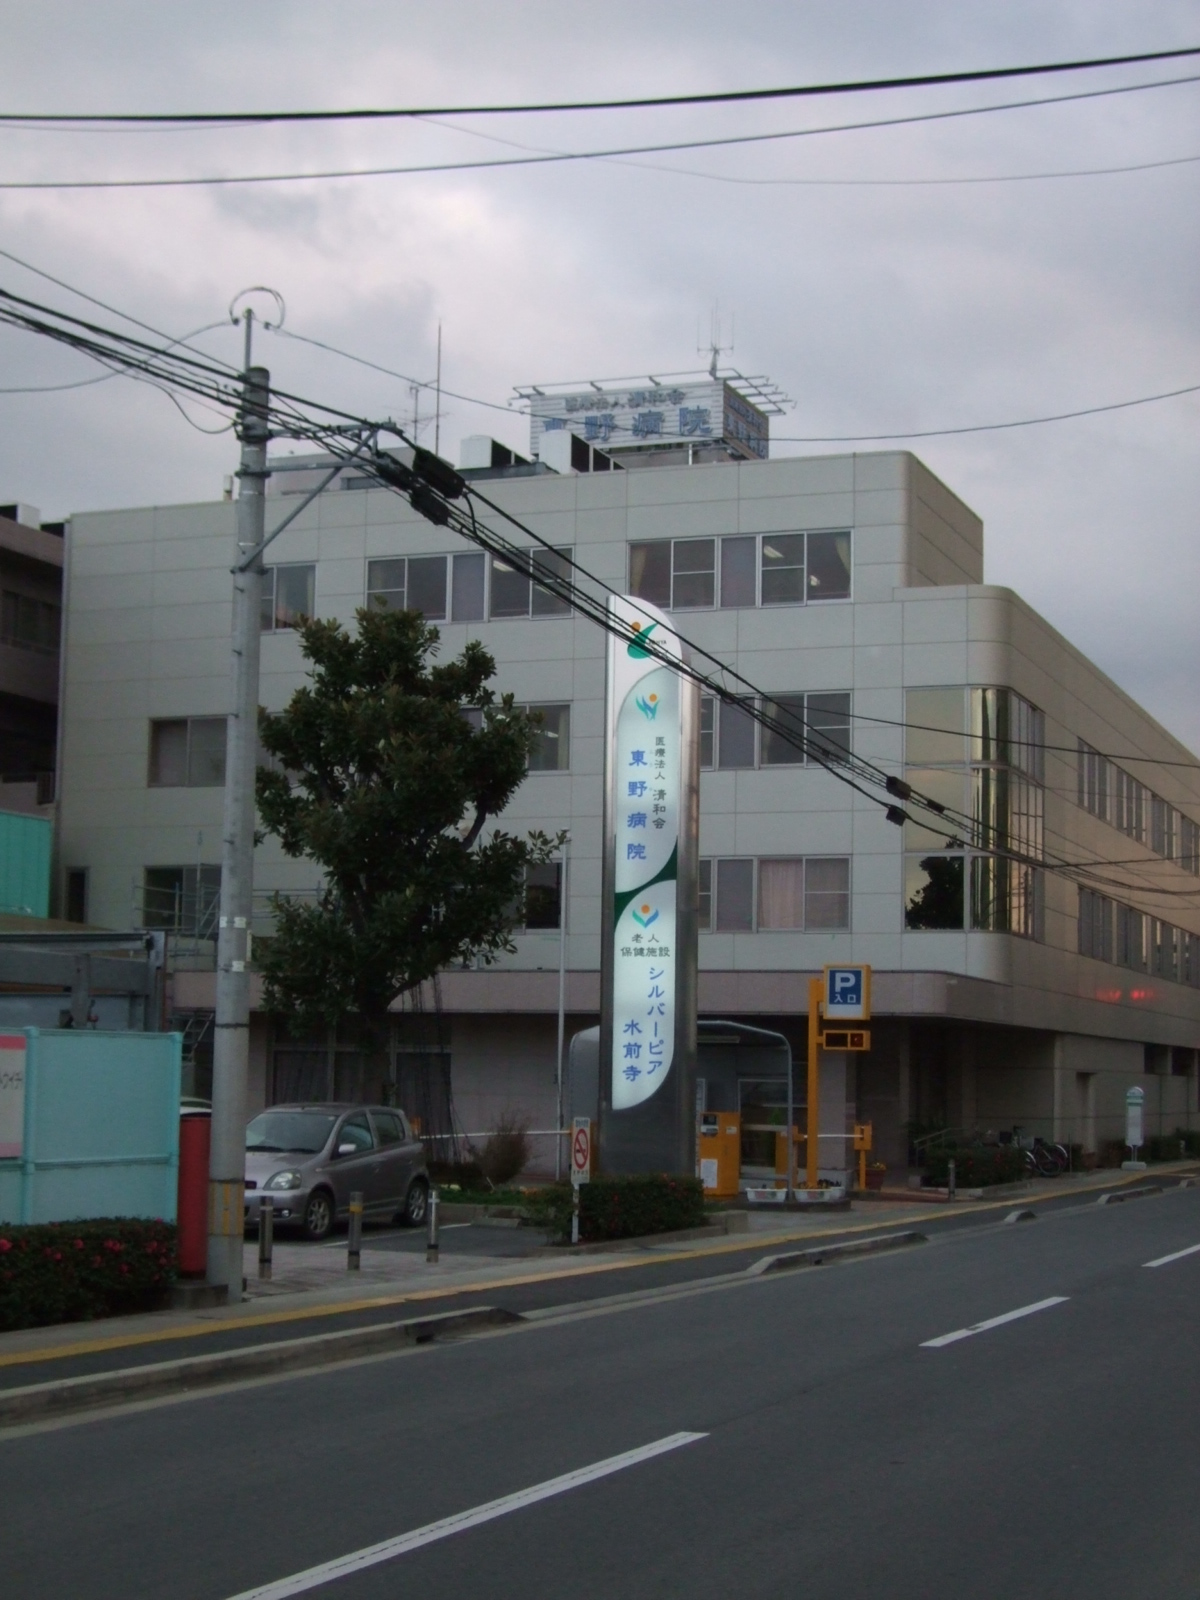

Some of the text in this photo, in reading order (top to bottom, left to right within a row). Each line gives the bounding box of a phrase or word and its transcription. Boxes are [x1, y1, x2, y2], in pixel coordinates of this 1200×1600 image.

[627, 750, 648, 860] 東野病院
[631, 933, 660, 943] 老人
[621, 946, 670, 957] 保健施設
[835, 972, 856, 992] P
[834, 993, 856, 1003] 入口
[647, 967, 665, 1075] シルバーピア
[622, 1019, 642, 1082] 水前寺
